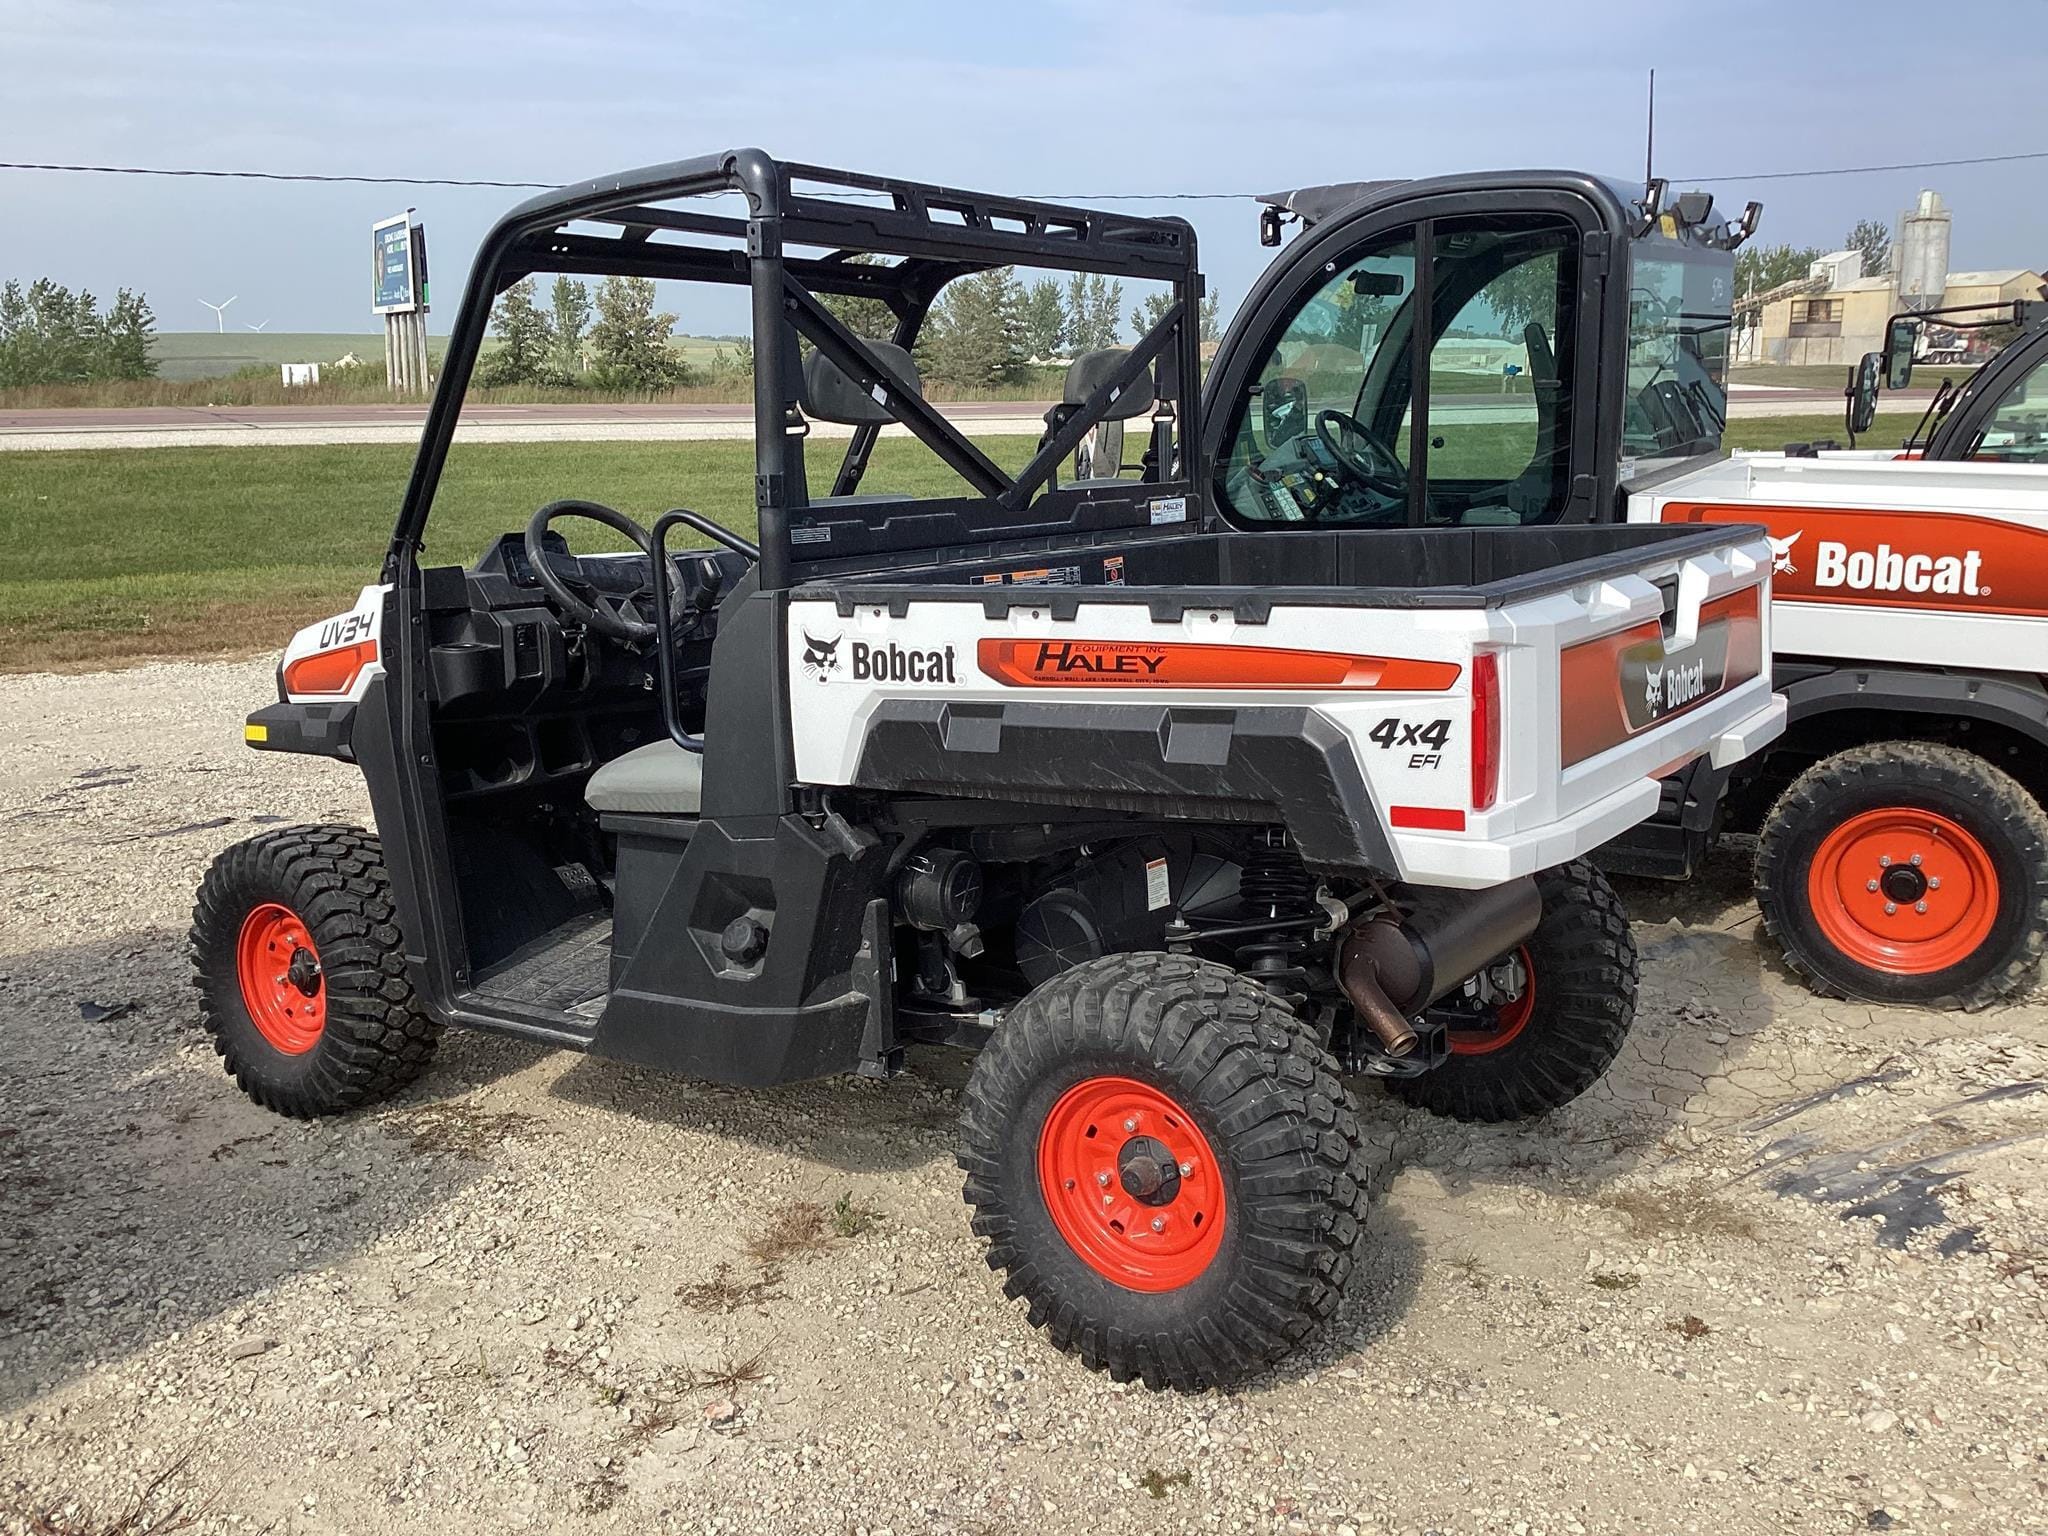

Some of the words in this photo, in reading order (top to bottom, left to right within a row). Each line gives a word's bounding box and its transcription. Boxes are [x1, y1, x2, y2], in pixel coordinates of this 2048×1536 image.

[1815, 540, 1982, 595] Bobcat
[319, 611, 375, 649] UV34
[852, 642, 956, 683] Bobcat
[1034, 642, 1168, 673] HALEY
[1075, 645, 1141, 654] EQUIPMENT
[1145, 646, 1168, 654] INC.
[1667, 657, 1704, 710] Bobcat
[1368, 718, 1452, 751] 4x4
[1407, 754, 1442, 770] EFI
